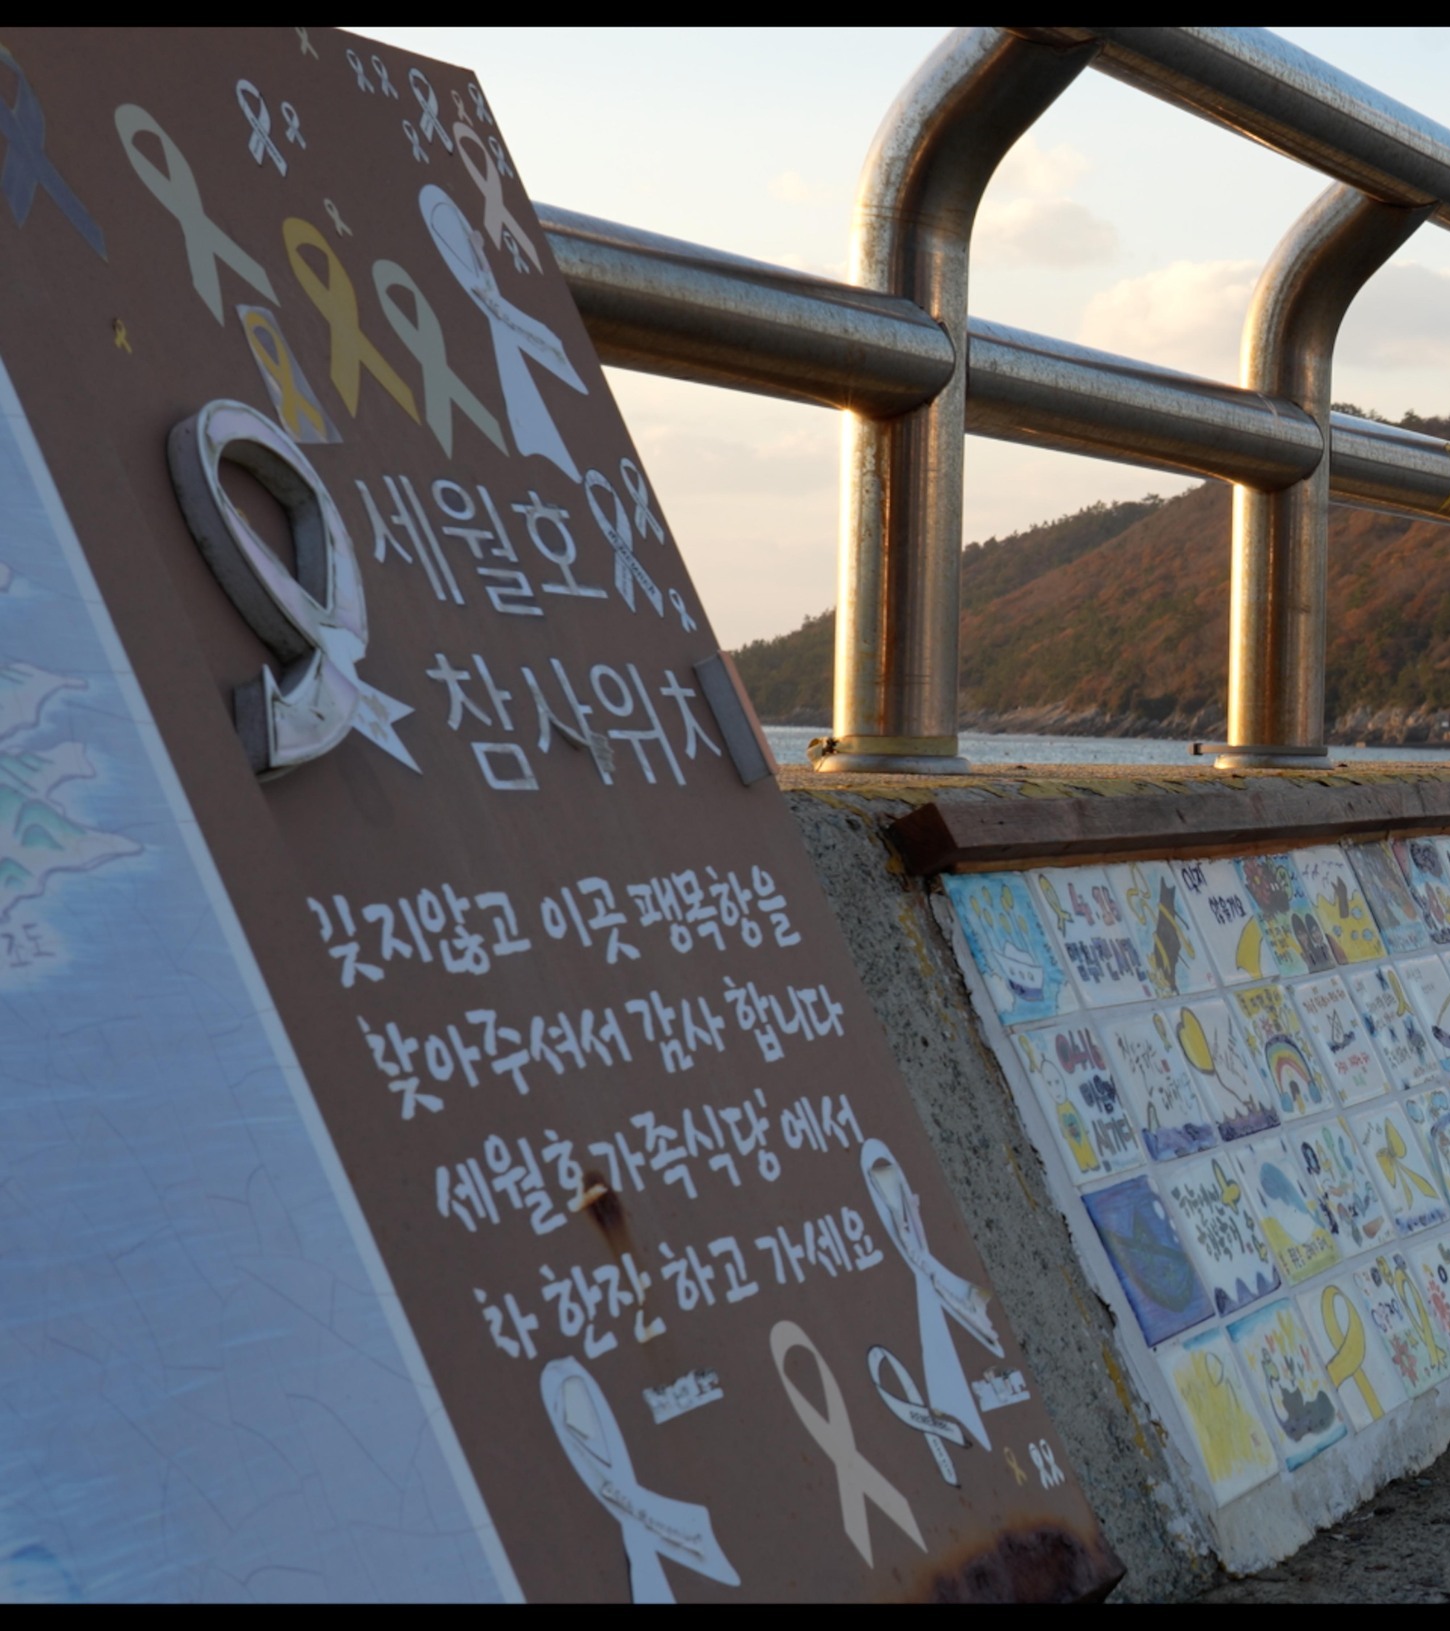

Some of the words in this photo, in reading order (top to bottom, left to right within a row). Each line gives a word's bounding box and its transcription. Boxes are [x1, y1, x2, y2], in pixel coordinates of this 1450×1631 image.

[355, 475, 608, 617] 세월호
[425, 652, 722, 791] 참사위치
[541, 876, 642, 965] 이곳
[627, 864, 802, 954] 팽목항을
[356, 1014, 632, 1119] 찾아주셔서
[627, 990, 726, 1074] 감사
[724, 975, 844, 1063] 합니다
[539, 1252, 667, 1360] 한잔
[658, 1235, 759, 1311] 하고
[754, 1205, 884, 1285] 가세요
